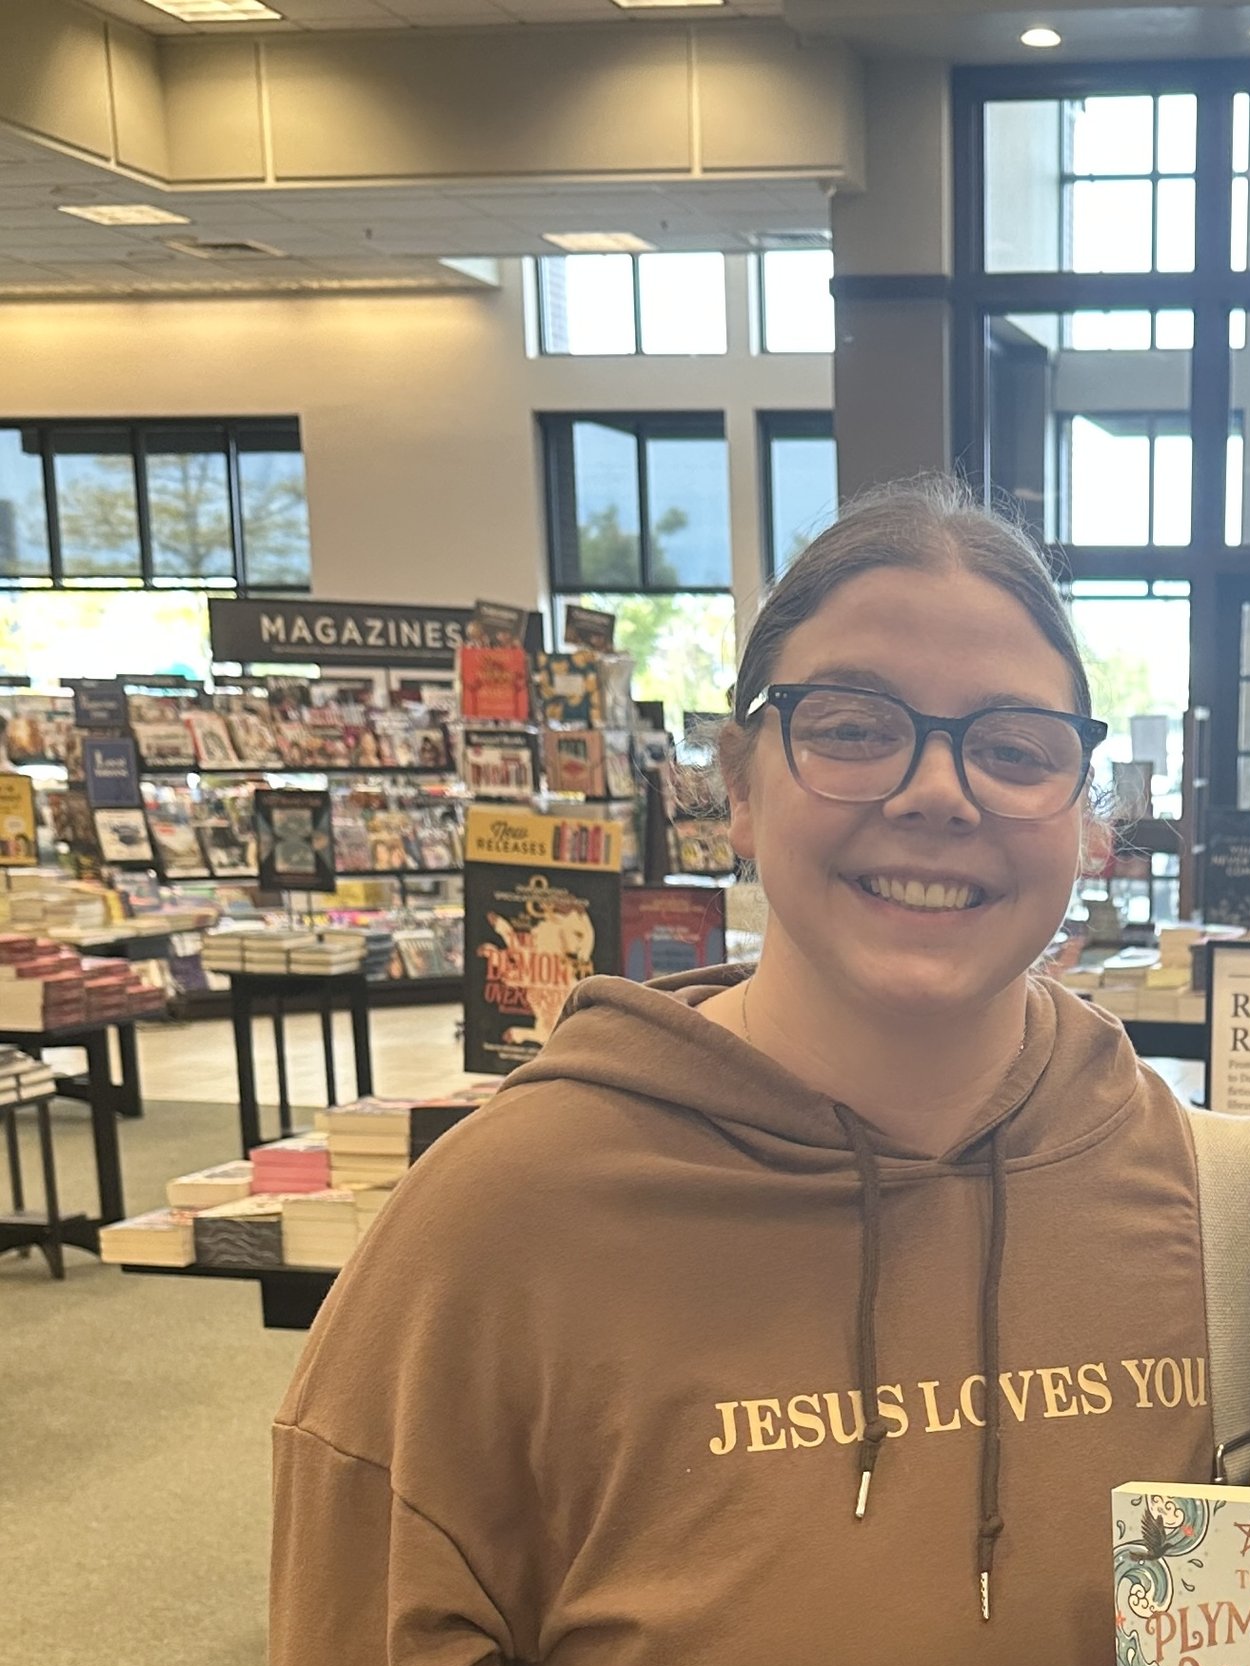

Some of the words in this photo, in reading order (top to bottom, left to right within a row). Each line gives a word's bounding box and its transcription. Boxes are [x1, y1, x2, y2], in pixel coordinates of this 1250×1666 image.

[259, 613, 464, 649] MAGAZINES
[476, 836, 547, 856] RELEASES
[709, 1384, 909, 1456] JESUS
[918, 1363, 1113, 1433] LOVES
[1121, 1357, 1207, 1409] YOU
